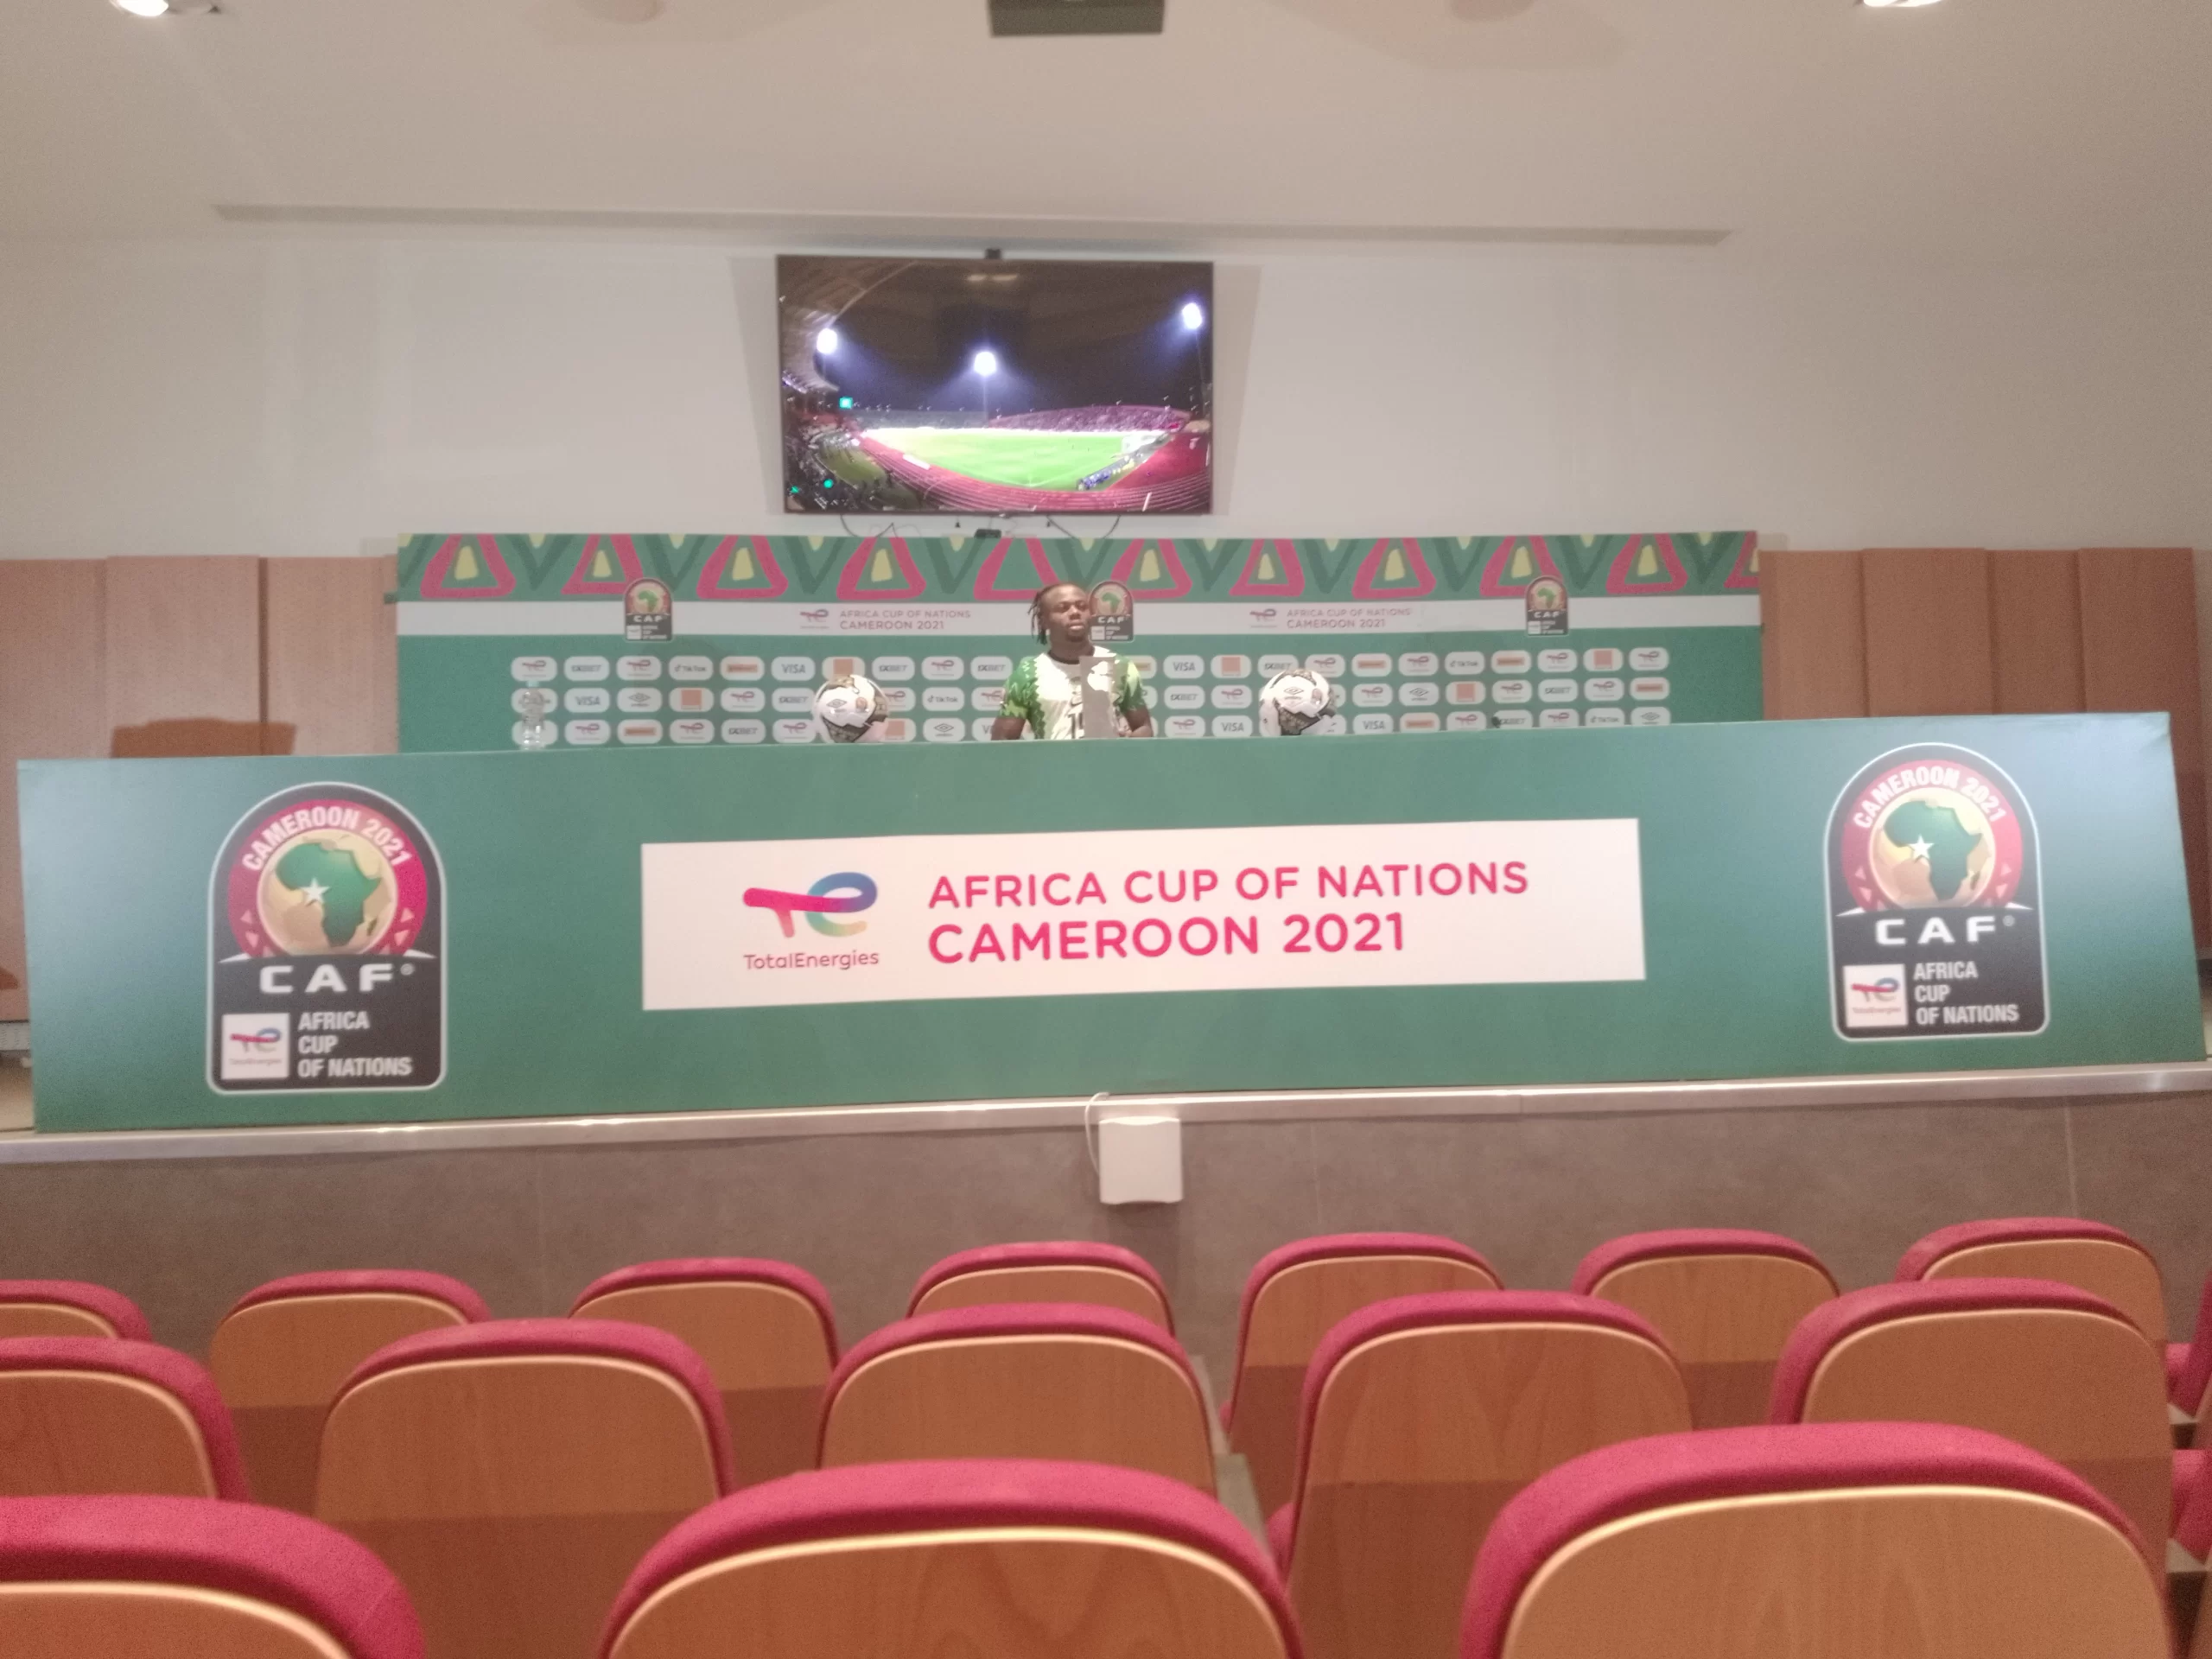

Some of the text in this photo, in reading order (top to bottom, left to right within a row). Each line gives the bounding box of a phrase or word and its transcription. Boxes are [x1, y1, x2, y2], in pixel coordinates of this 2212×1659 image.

[840, 610, 880, 619] AFRICA
[924, 610, 971, 619] NATIONS
[1350, 608, 1363, 617] OF
[840, 620, 912, 630] CAMEROON
[917, 620, 944, 630] 2021
[1287, 619, 1356, 629] CAMEROON
[1359, 619, 1386, 628] 2021
[781, 664, 806, 674] VISA
[1173, 662, 1196, 671] VISA
[575, 696, 601, 706] VISA
[1220, 721, 1245, 732] VISA
[1362, 720, 1386, 730] VISA
[1853, 766, 2006, 829] CAMEROON 2021
[242, 805, 412, 871] CAMEROON 2021
[929, 861, 1529, 909] AFRICA CUP OF NATIONS
[928, 912, 1403, 964] CAMEROON 2021
[1875, 915, 1997, 945] CAF
[743, 950, 880, 970] TotalEnergies
[260, 963, 395, 994] CAF
[1913, 961, 1979, 981] AFRICA
[1915, 984, 1951, 1003] CUP
[298, 1011, 370, 1030] AFRICA
[1916, 1004, 2020, 1026] OF NATIONS
[298, 1035, 339, 1054] CUP
[298, 1058, 325, 1077] OF
[328, 1057, 413, 1077] NATIONS
